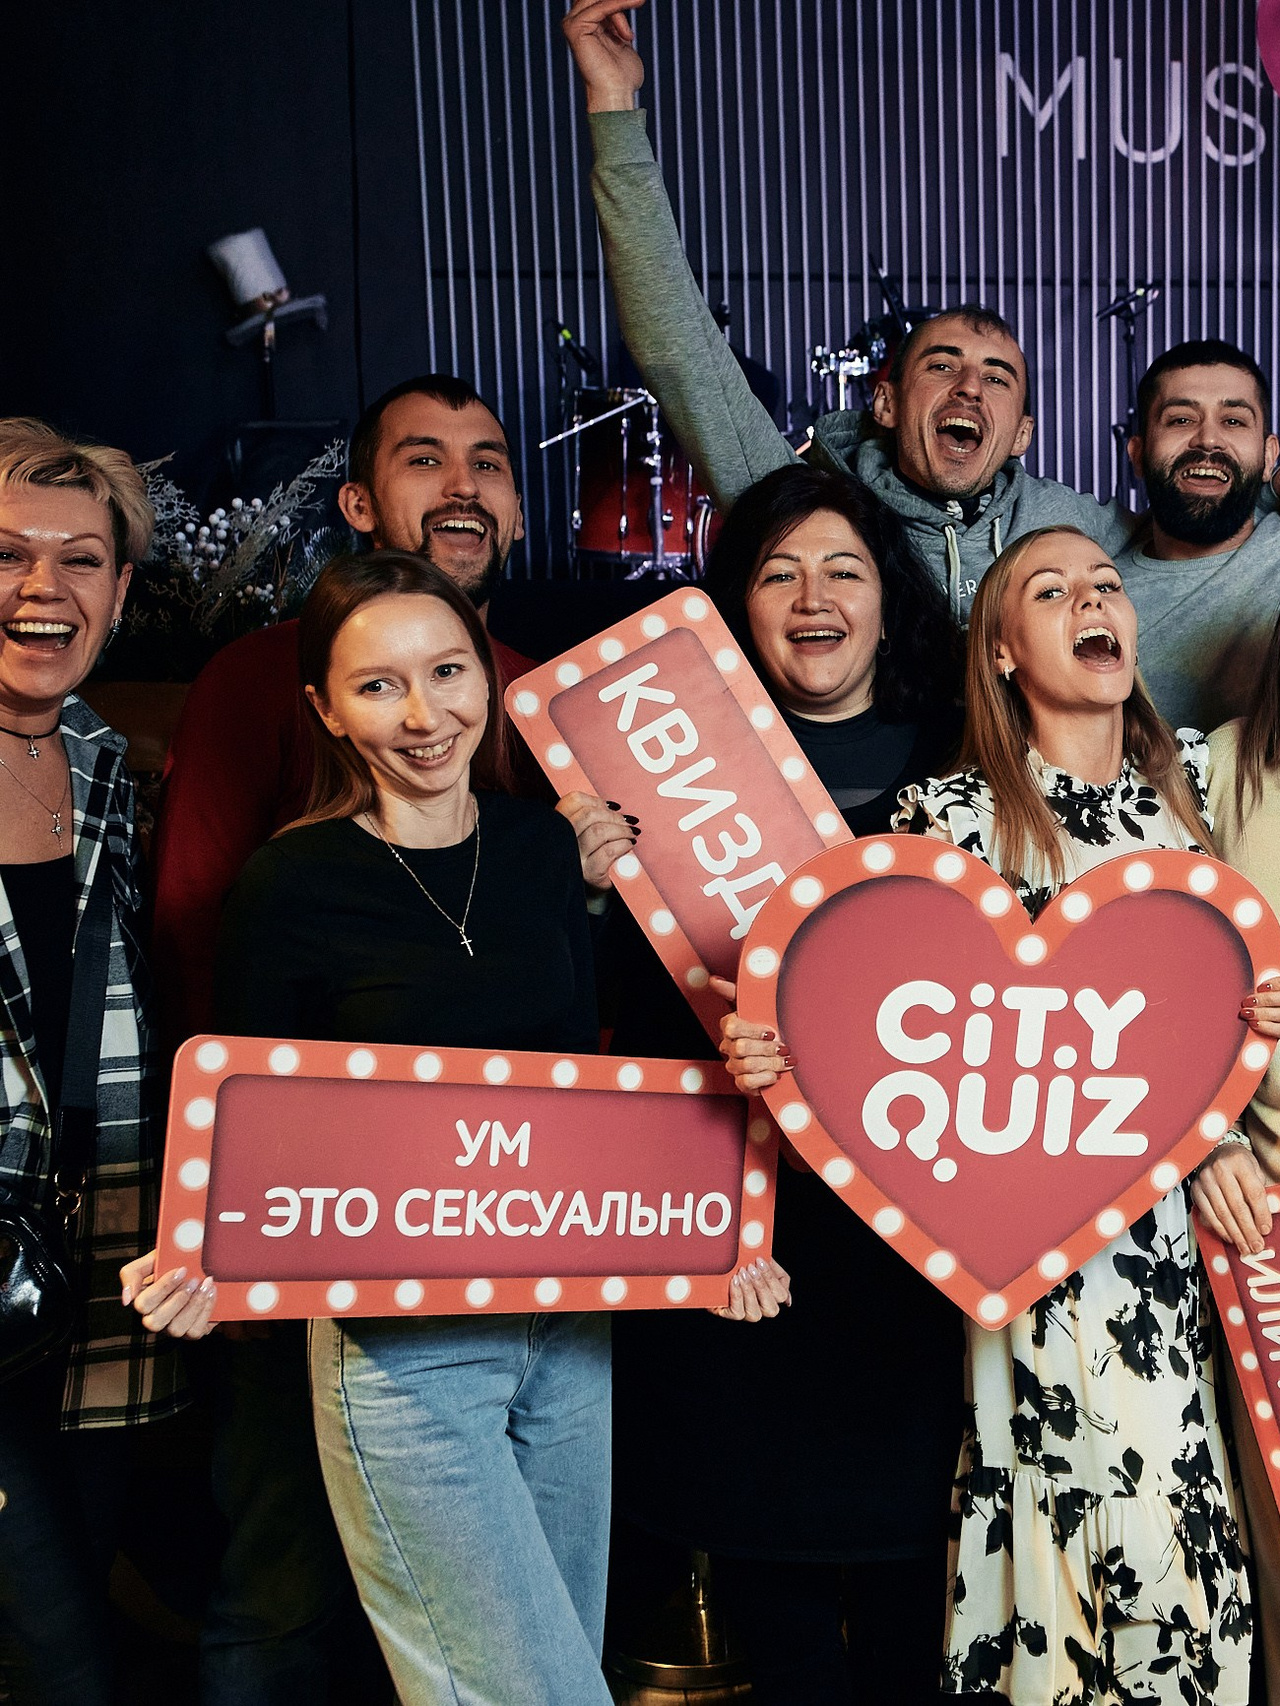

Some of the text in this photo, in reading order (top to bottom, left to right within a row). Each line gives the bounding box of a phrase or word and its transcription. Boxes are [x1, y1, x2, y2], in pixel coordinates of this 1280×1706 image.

[454, 1119, 532, 1168] УМ
[260, 1186, 379, 1238] ЭТО
[393, 1187, 733, 1238] СЕКСУАЛЬНО
